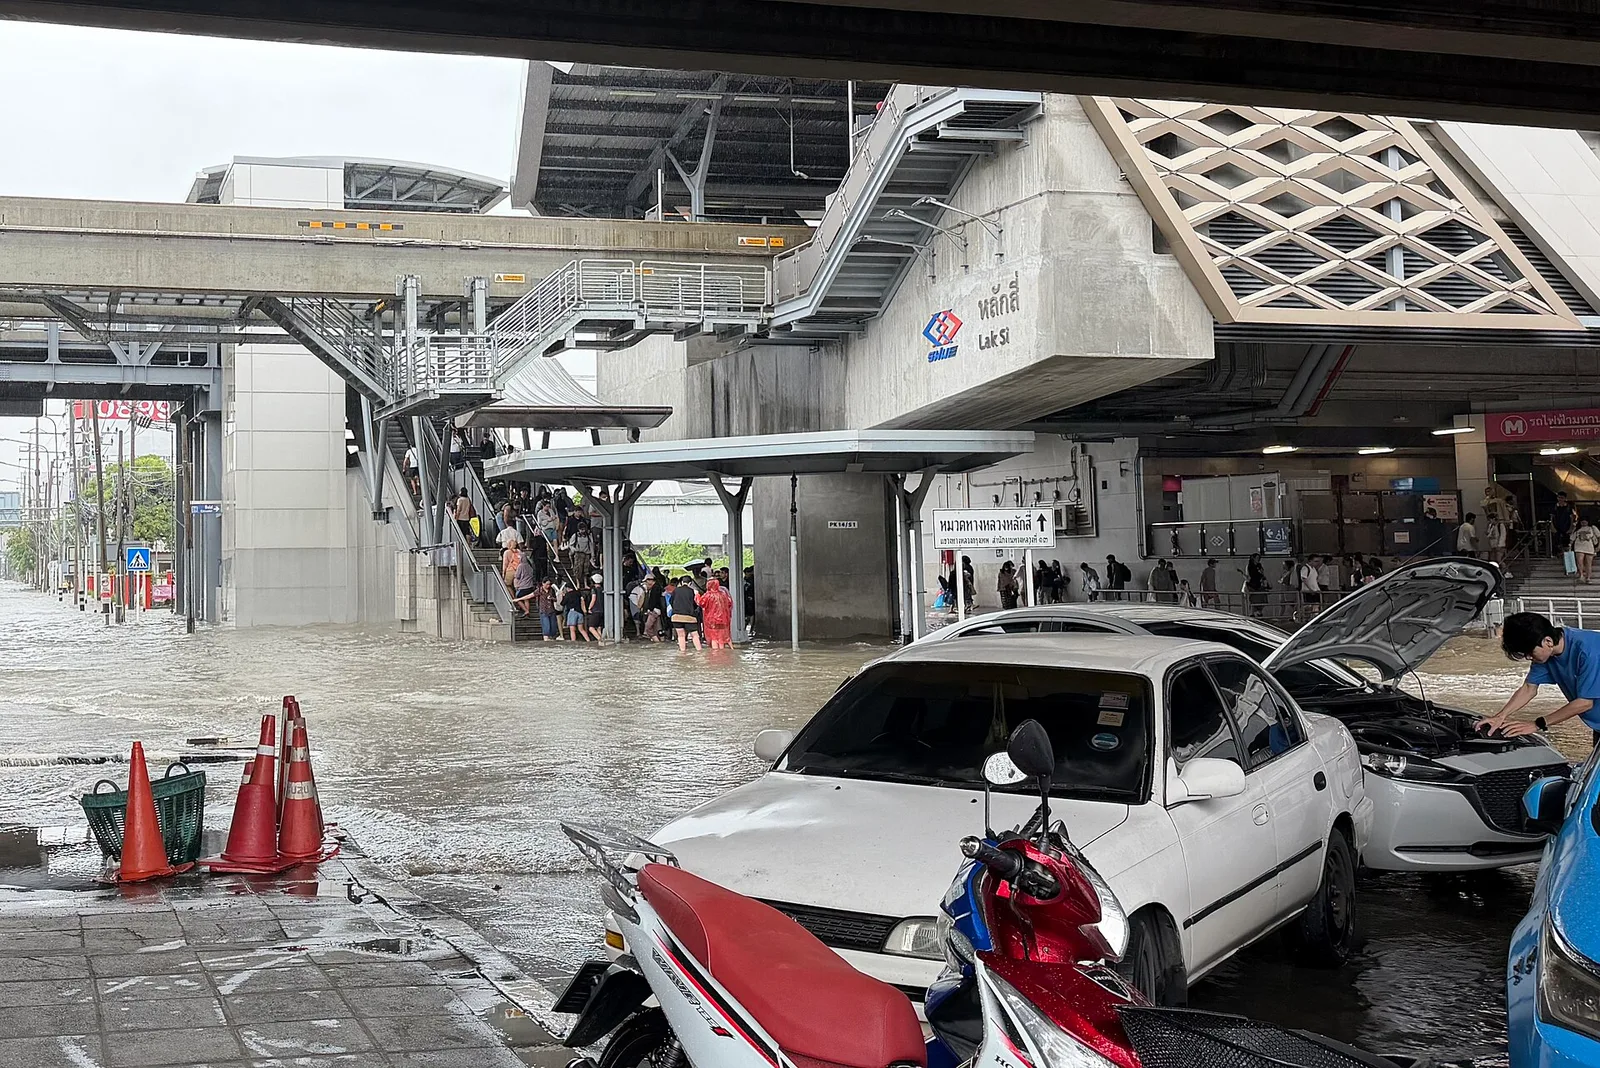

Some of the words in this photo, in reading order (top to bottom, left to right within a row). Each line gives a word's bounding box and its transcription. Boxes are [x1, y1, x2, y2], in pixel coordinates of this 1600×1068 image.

[977, 270, 1019, 320] หลักสี่
[978, 330, 998, 351] Lak
[999, 326, 1010, 346] Si
[1571, 428, 1591, 436] MRT
[939, 511, 1032, 532] หมวดทางหลวงหลักสี่
[652, 947, 701, 1006] WAVE
